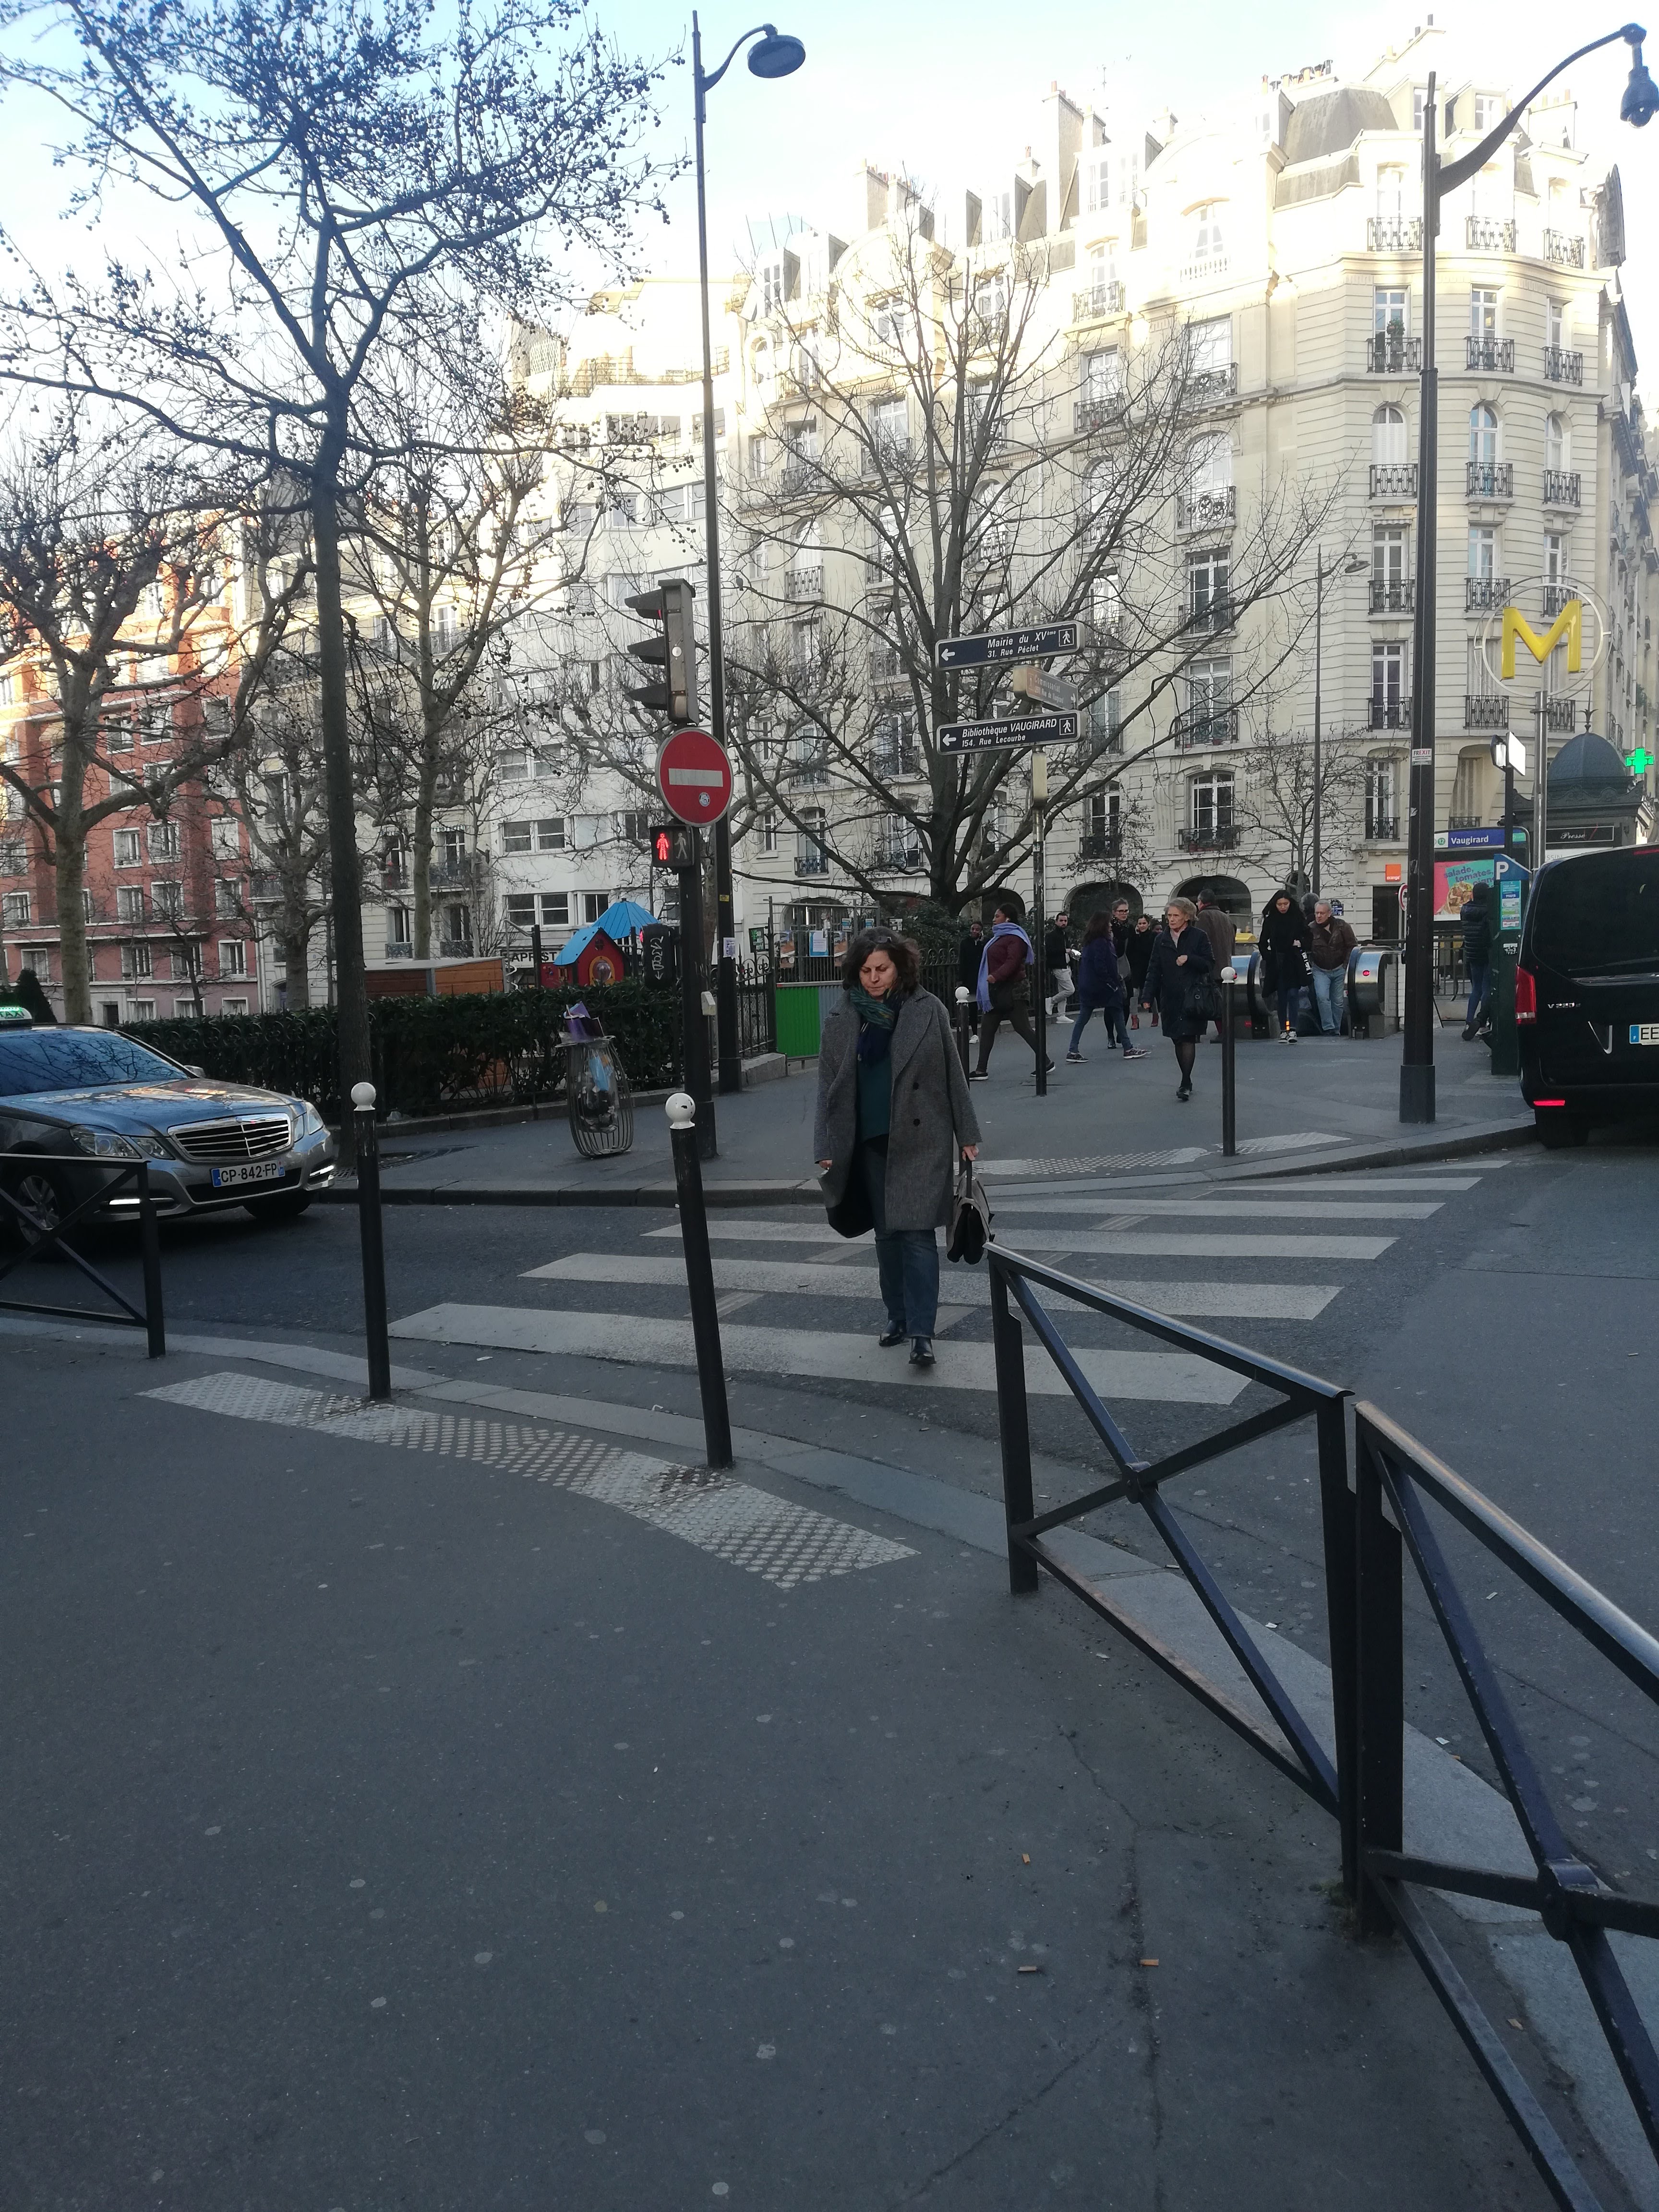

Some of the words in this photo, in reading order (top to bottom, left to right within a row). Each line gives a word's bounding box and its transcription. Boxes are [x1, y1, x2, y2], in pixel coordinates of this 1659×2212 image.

[987, 636, 1013, 649] Mairie
[1019, 634, 1029, 644] du
[1502, 600, 1582, 680] M
[1018, 644, 1039, 654] Péclet
[962, 726, 1008, 738] Bibliothèque
[1010, 718, 1057, 733] VAUGIRARD
[996, 734, 1026, 744] Lecourbe
[1451, 835, 1489, 845] Vaugirard
[1443, 866, 1474, 878] salade,
[1455, 869, 1494, 882] tomates,
[1496, 861, 1509, 880] P
